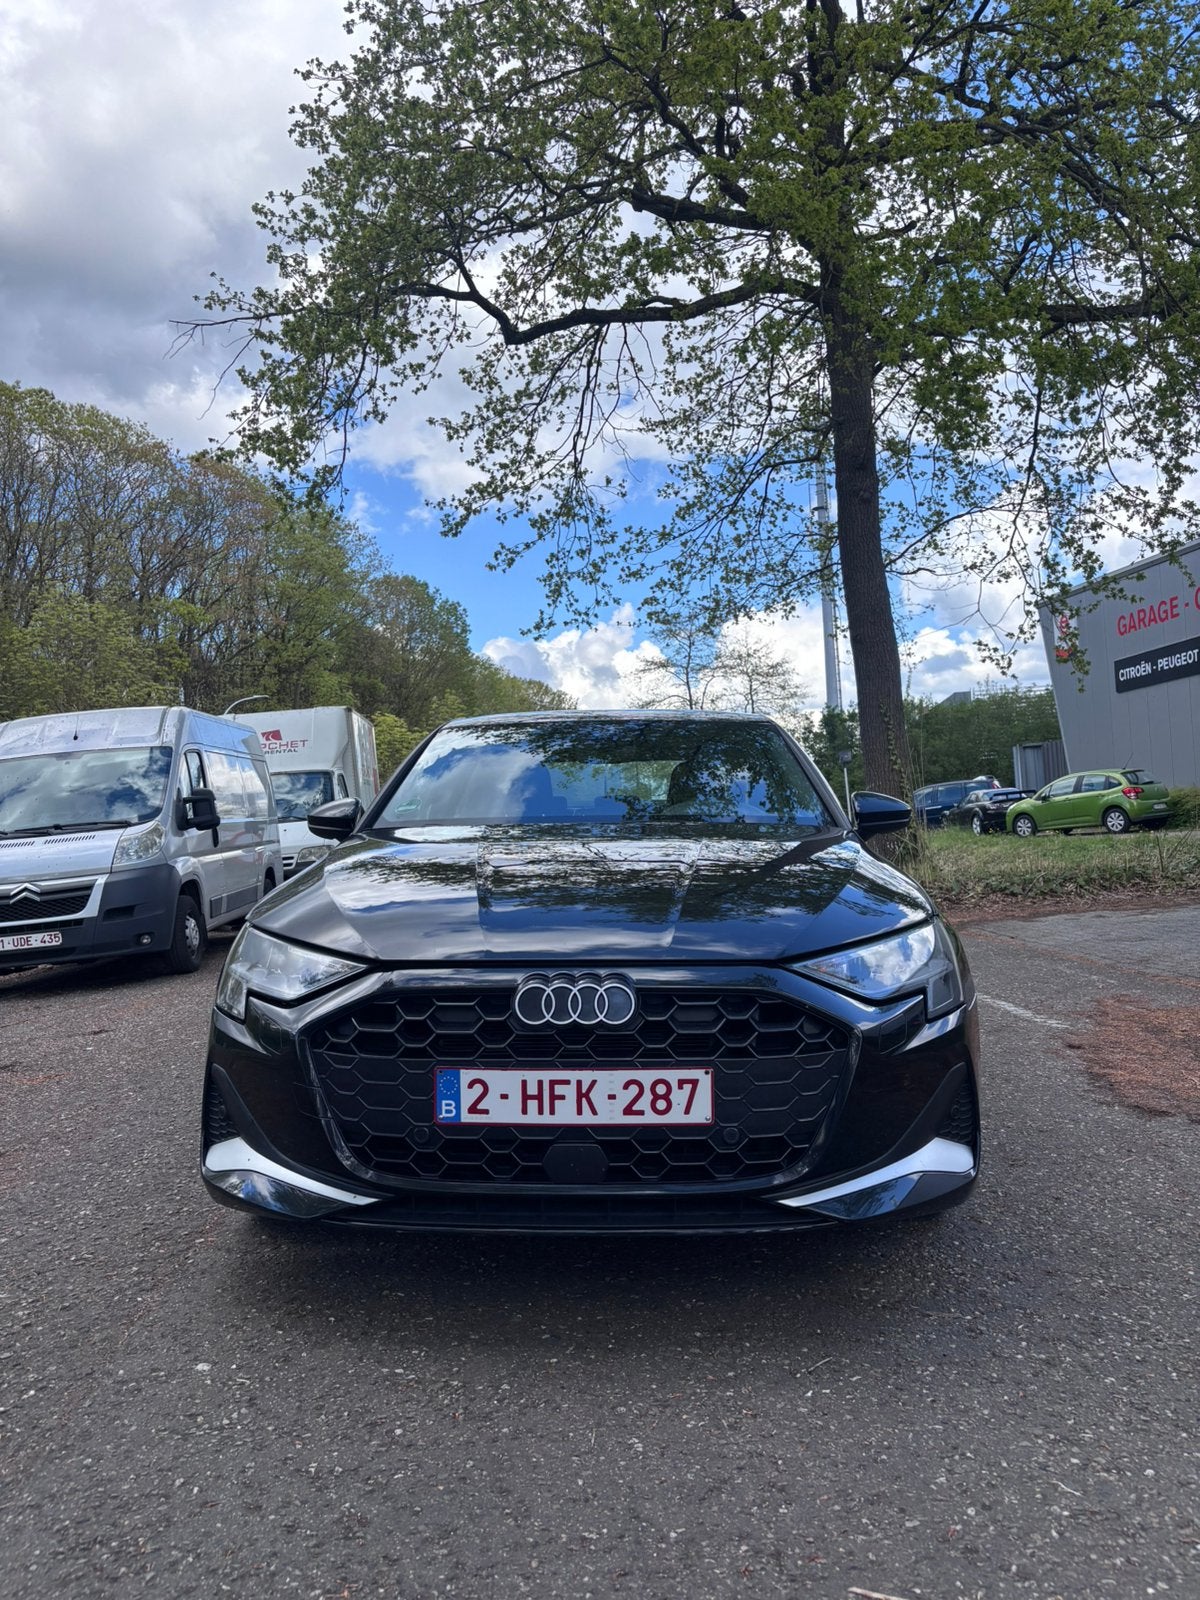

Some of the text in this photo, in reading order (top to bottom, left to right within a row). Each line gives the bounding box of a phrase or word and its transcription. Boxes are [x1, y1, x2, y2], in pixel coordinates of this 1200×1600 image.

[1117, 595, 1180, 636] GARAGE
[1119, 661, 1151, 681] CITROËN
[1157, 649, 1199, 671] PEUGEOT
[442, 1100, 456, 1117] B
[467, 1078, 700, 1116] 2-HFK-287
